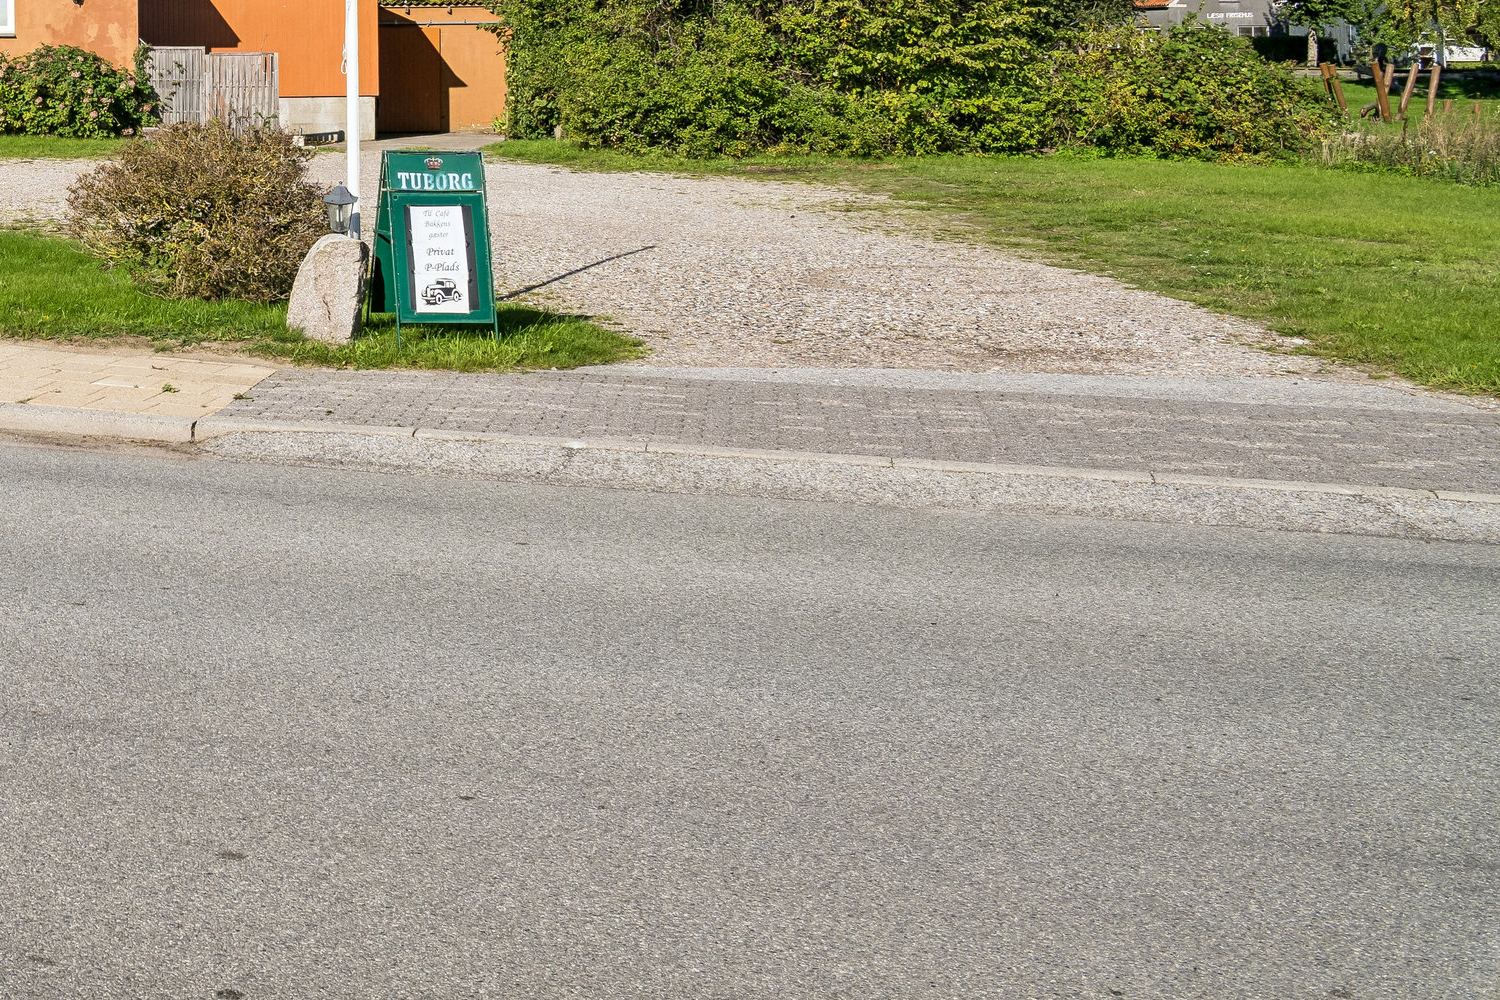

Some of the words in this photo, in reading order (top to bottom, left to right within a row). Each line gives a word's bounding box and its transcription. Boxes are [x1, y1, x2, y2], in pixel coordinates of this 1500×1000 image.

[397, 172, 474, 190] TUBORG
[425, 220, 451, 228] Bakkens
[428, 232, 449, 240] gæster
[426, 247, 454, 256] Privat
[424, 261, 460, 271] P-Plads
